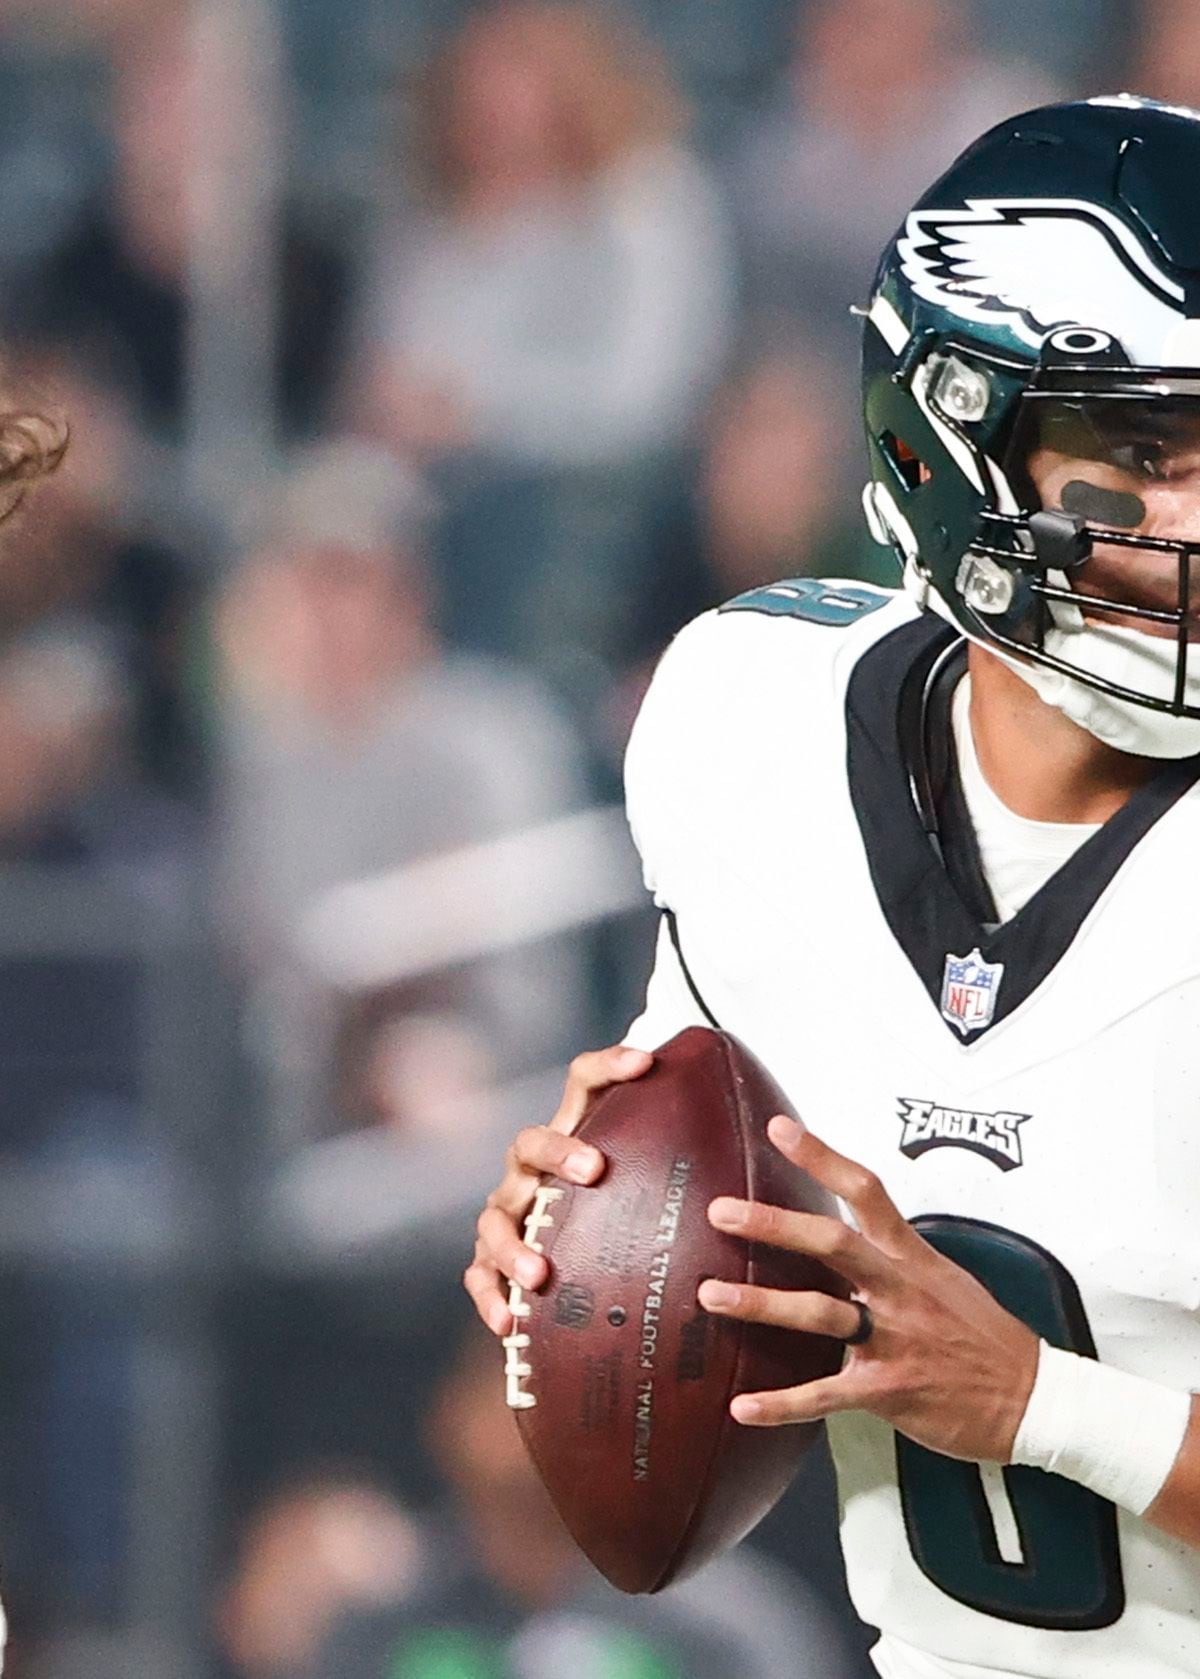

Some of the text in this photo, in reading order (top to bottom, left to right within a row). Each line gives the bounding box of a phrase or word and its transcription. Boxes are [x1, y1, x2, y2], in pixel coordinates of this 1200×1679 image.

[717, 577, 893, 627] 8
[949, 986, 985, 1020] NFL
[896, 1097, 1033, 1172] EAGLES
[640, 1251, 669, 1368] FOOTBALL
